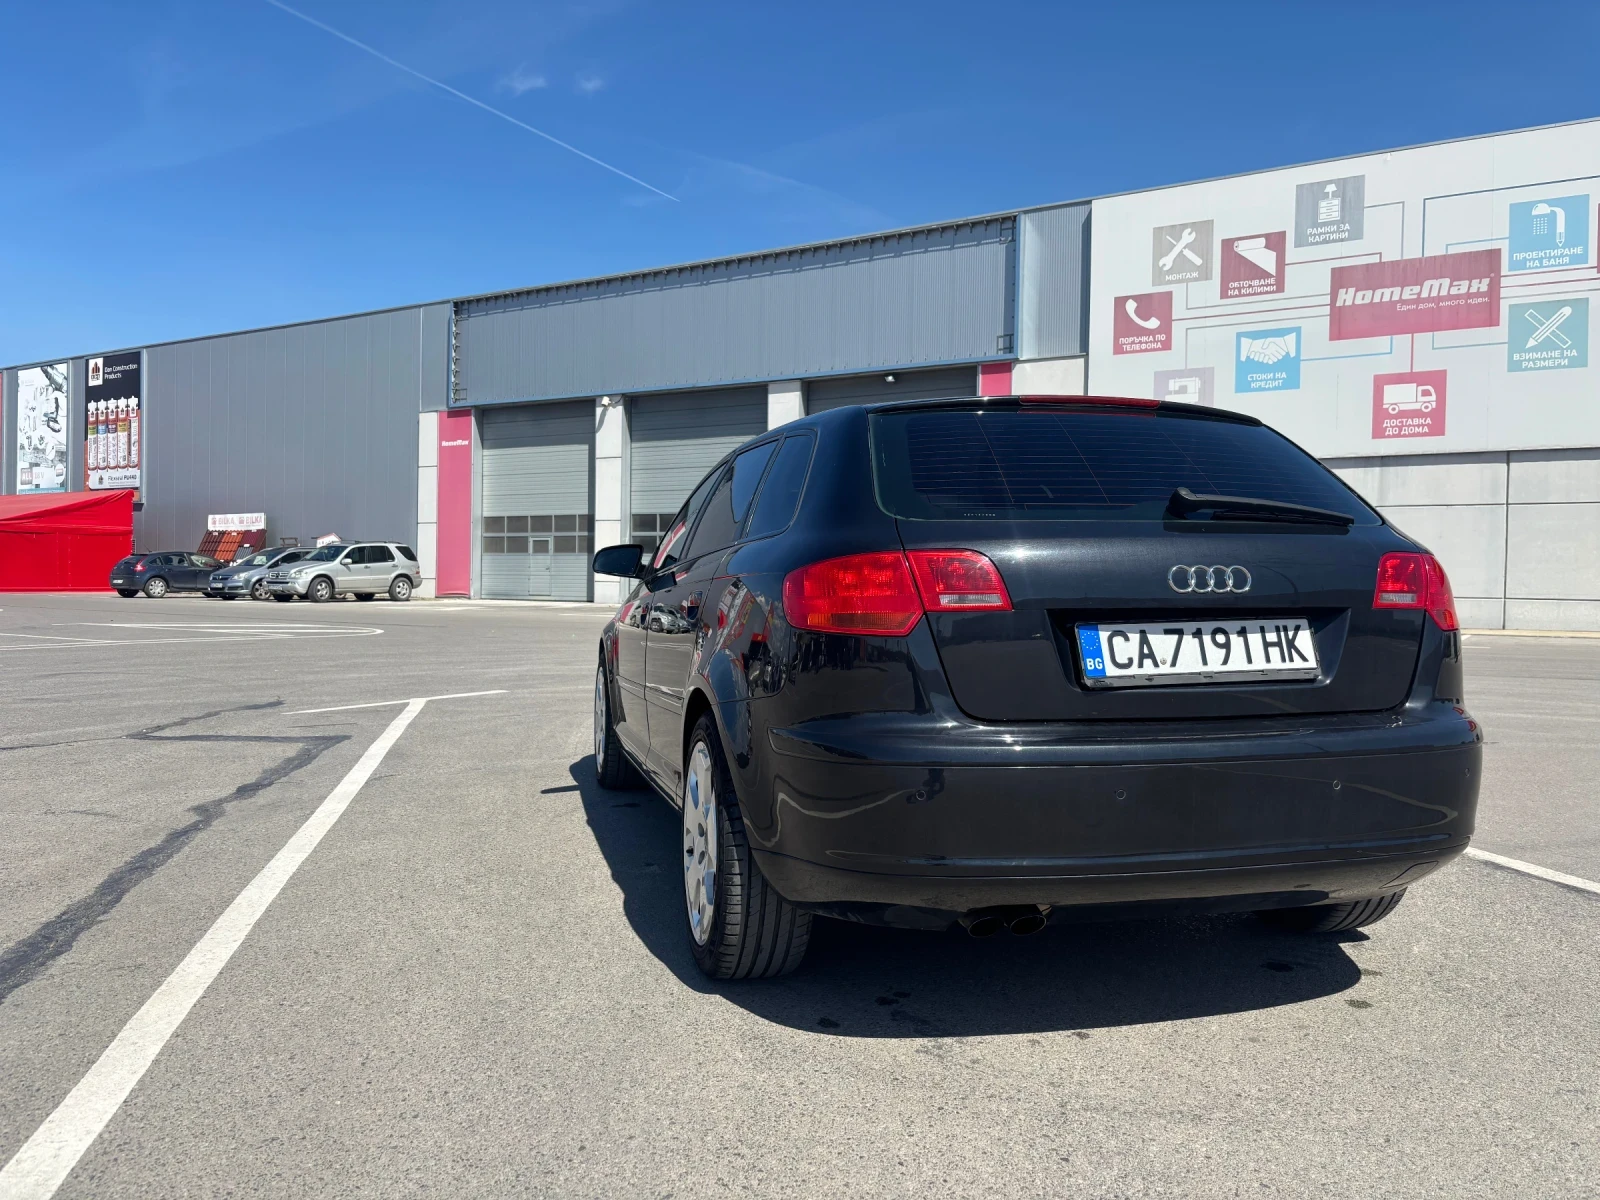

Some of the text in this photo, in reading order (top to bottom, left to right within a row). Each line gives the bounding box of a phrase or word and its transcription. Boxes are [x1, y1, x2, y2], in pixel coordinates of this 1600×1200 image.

[1307, 223, 1351, 236] РАМКИ ЗА
[1308, 231, 1349, 244] КАРТИНИ
[1513, 246, 1584, 261] ПРОЕКТИРАНЕ
[1526, 256, 1570, 268] НА БАНЯ
[1165, 270, 1199, 281] МОНТАЖ
[1228, 277, 1276, 288] ОБТОЧВАНЕ
[1228, 285, 1276, 296] НА КИЛИМИ
[1335, 276, 1491, 306] HomeMax
[1396, 296, 1490, 311] Един дом, много идеи.
[1118, 333, 1166, 345] ПОРЪЧКА ПО
[1122, 341, 1162, 352] ТЕЛЕФОНА
[1512, 349, 1578, 361] ВЗИМАНЕ НА
[1521, 359, 1568, 369] РАЗМЕРИ
[1247, 371, 1287, 381] СТОКИ НА
[1250, 380, 1283, 389] КРЕДИТ
[1383, 417, 1432, 428] ДОСТАВКА
[1385, 425, 1429, 435] ДО ДОМА
[245, 516, 263, 524] BILKA
[1086, 658, 1103, 671] BG
